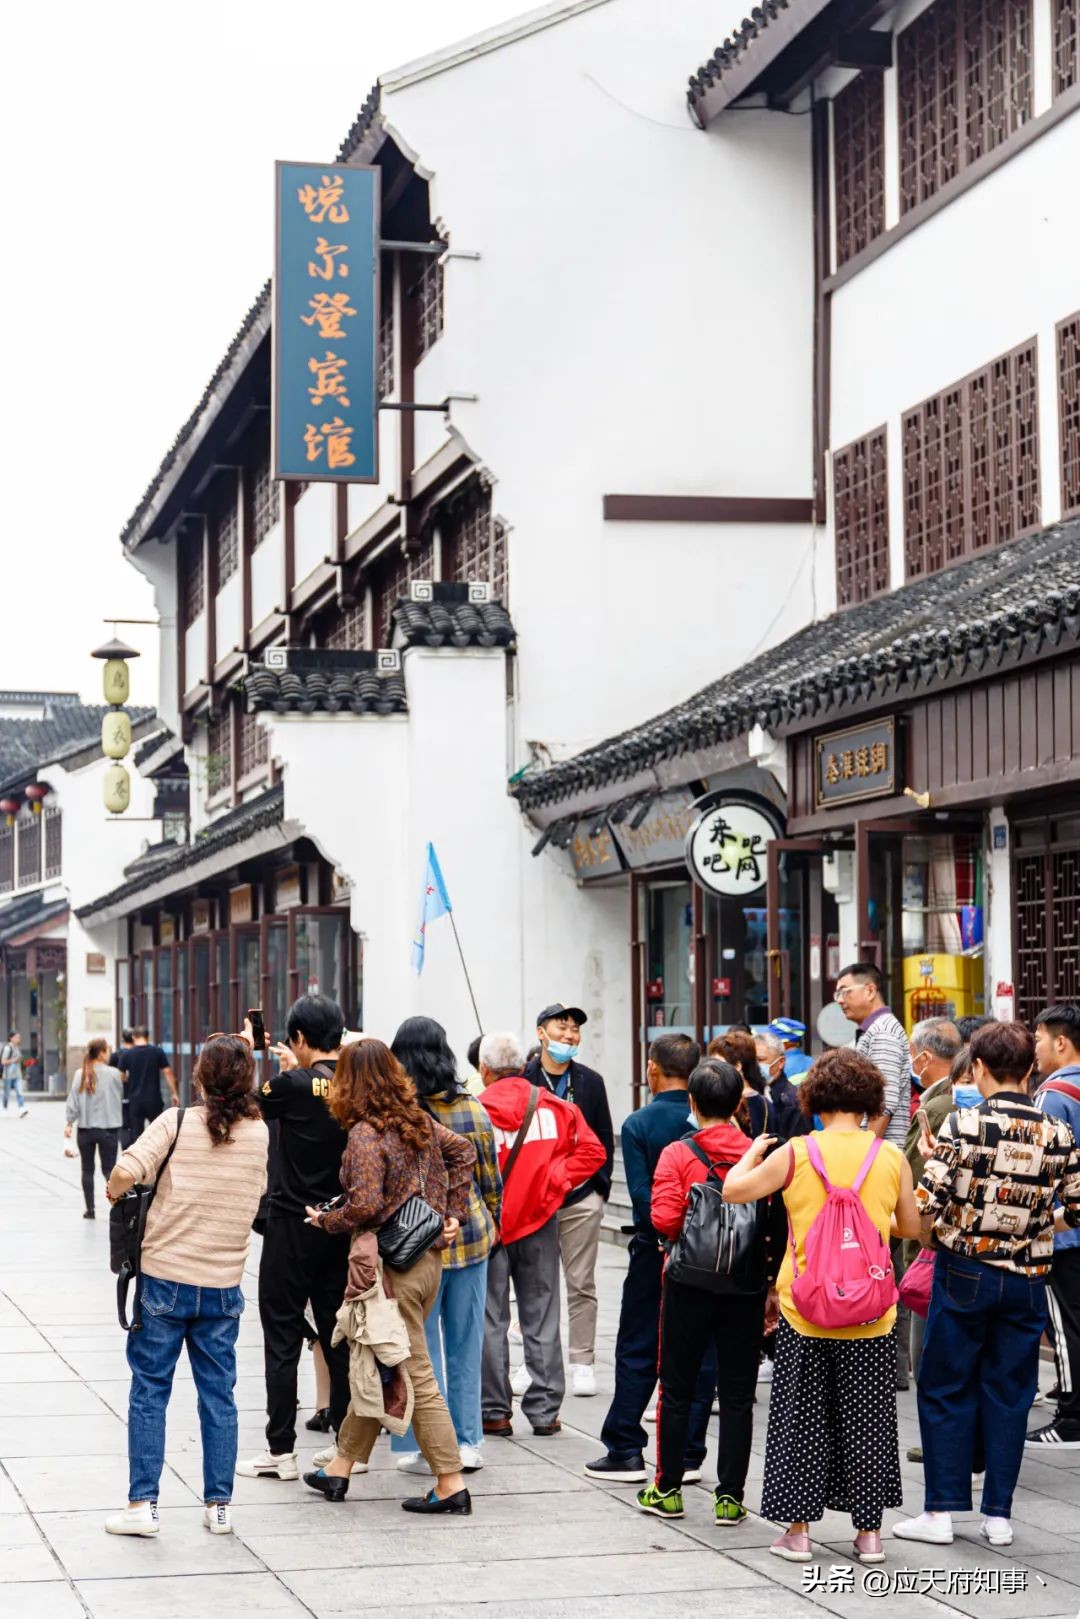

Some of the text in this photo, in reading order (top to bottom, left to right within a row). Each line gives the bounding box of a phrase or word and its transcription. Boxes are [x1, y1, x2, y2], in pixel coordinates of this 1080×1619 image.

[297, 175, 358, 470] 悦尔登宾馆
